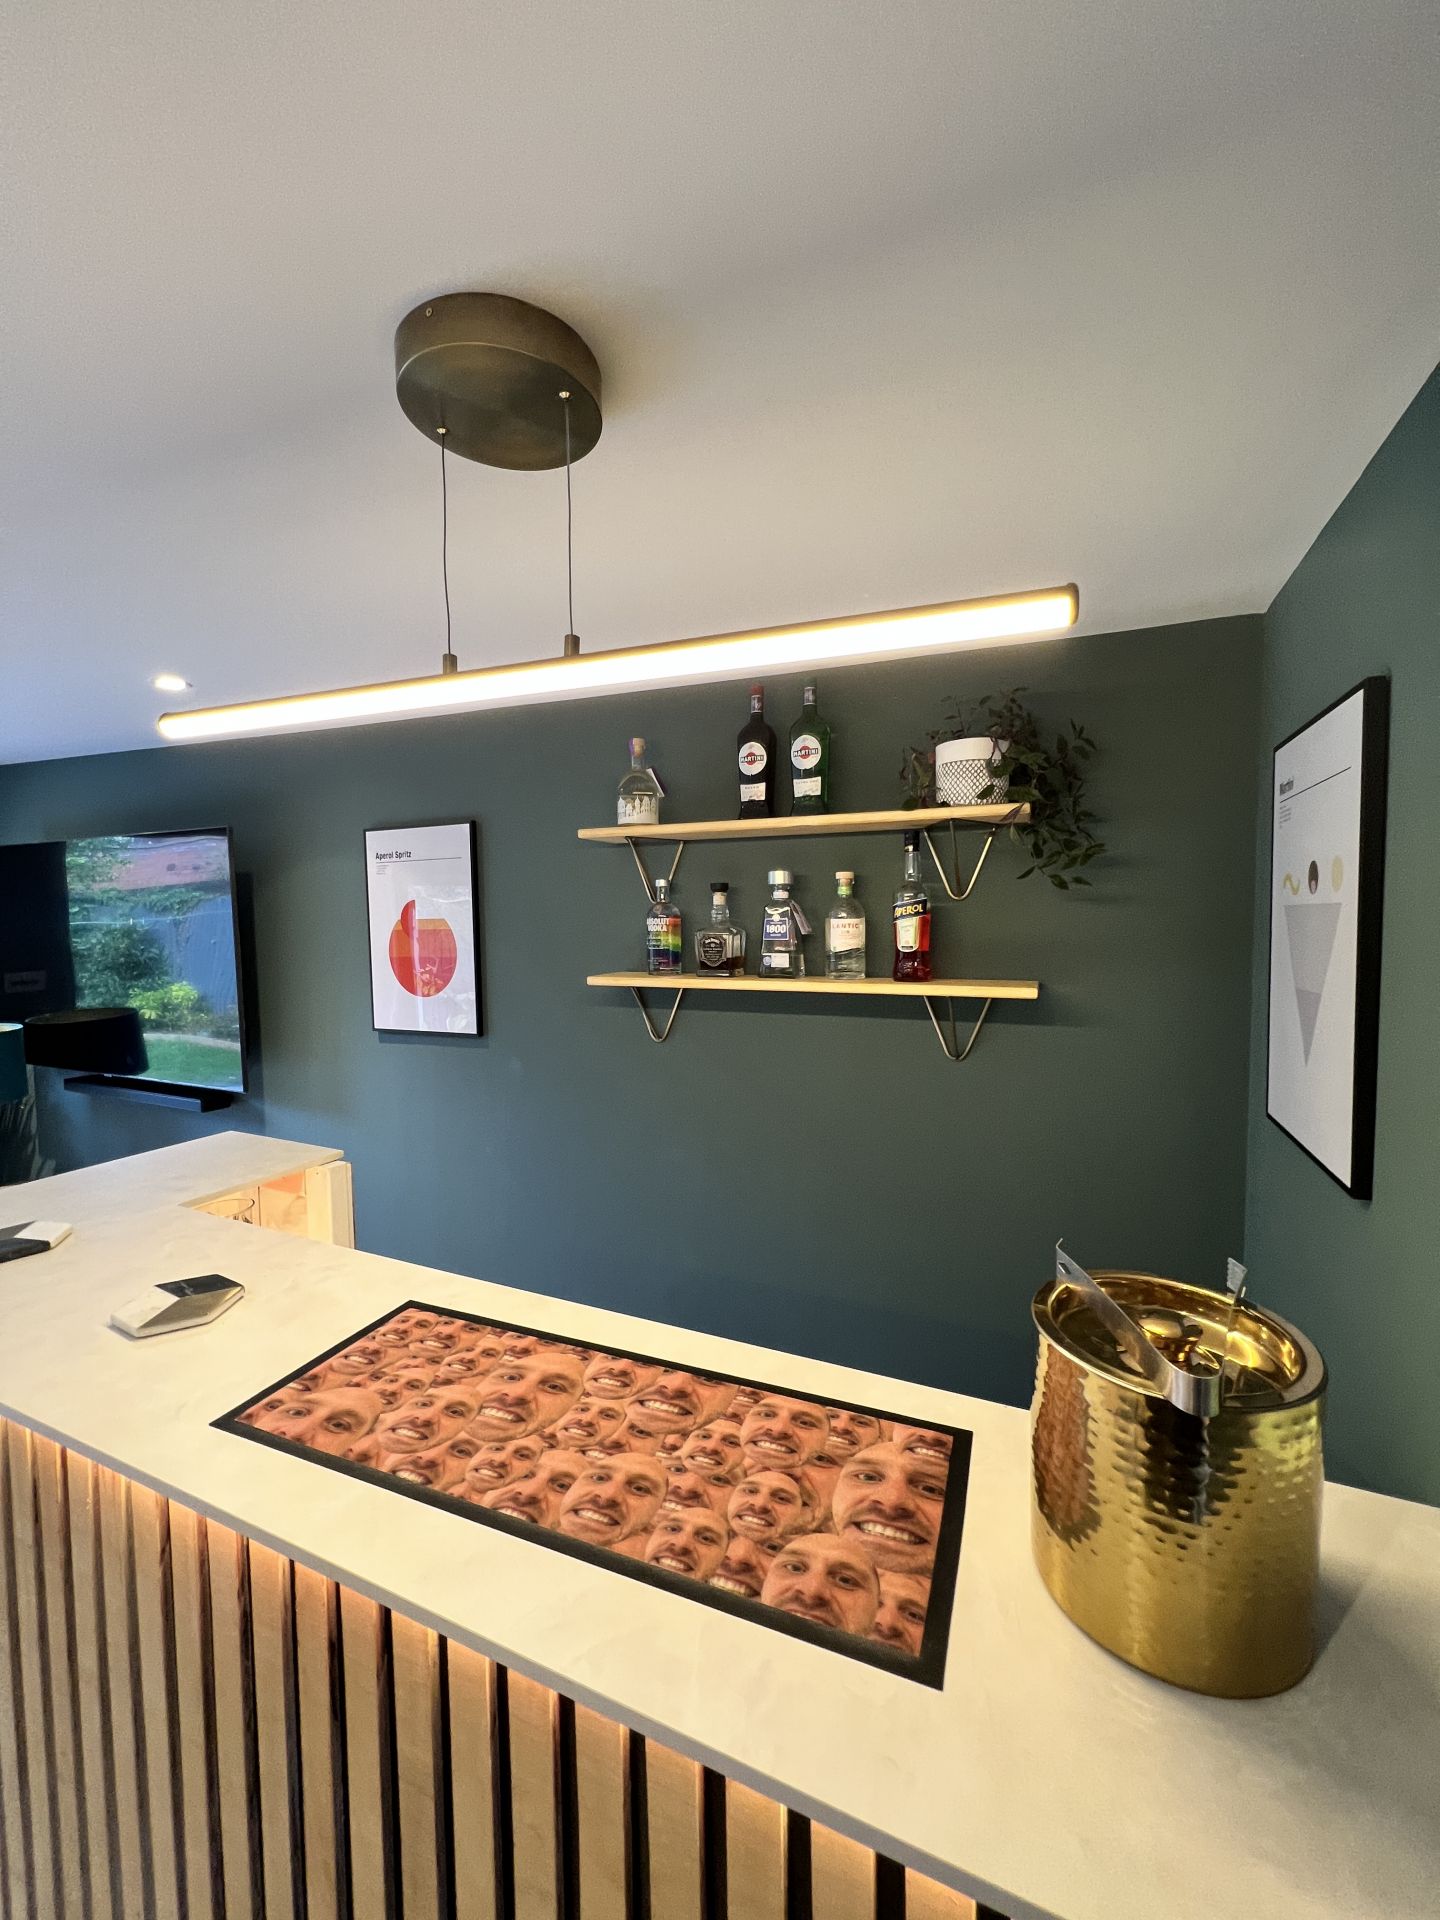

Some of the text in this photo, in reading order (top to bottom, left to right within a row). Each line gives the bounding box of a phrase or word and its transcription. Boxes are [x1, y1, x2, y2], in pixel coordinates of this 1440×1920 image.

[793, 747, 819, 757] MARTINI
[740, 754, 765, 763] MARTINI
[375, 850, 412, 861] Aperol Spritz
[893, 903, 924, 918] APEROL
[765, 923, 787, 934] 1800
